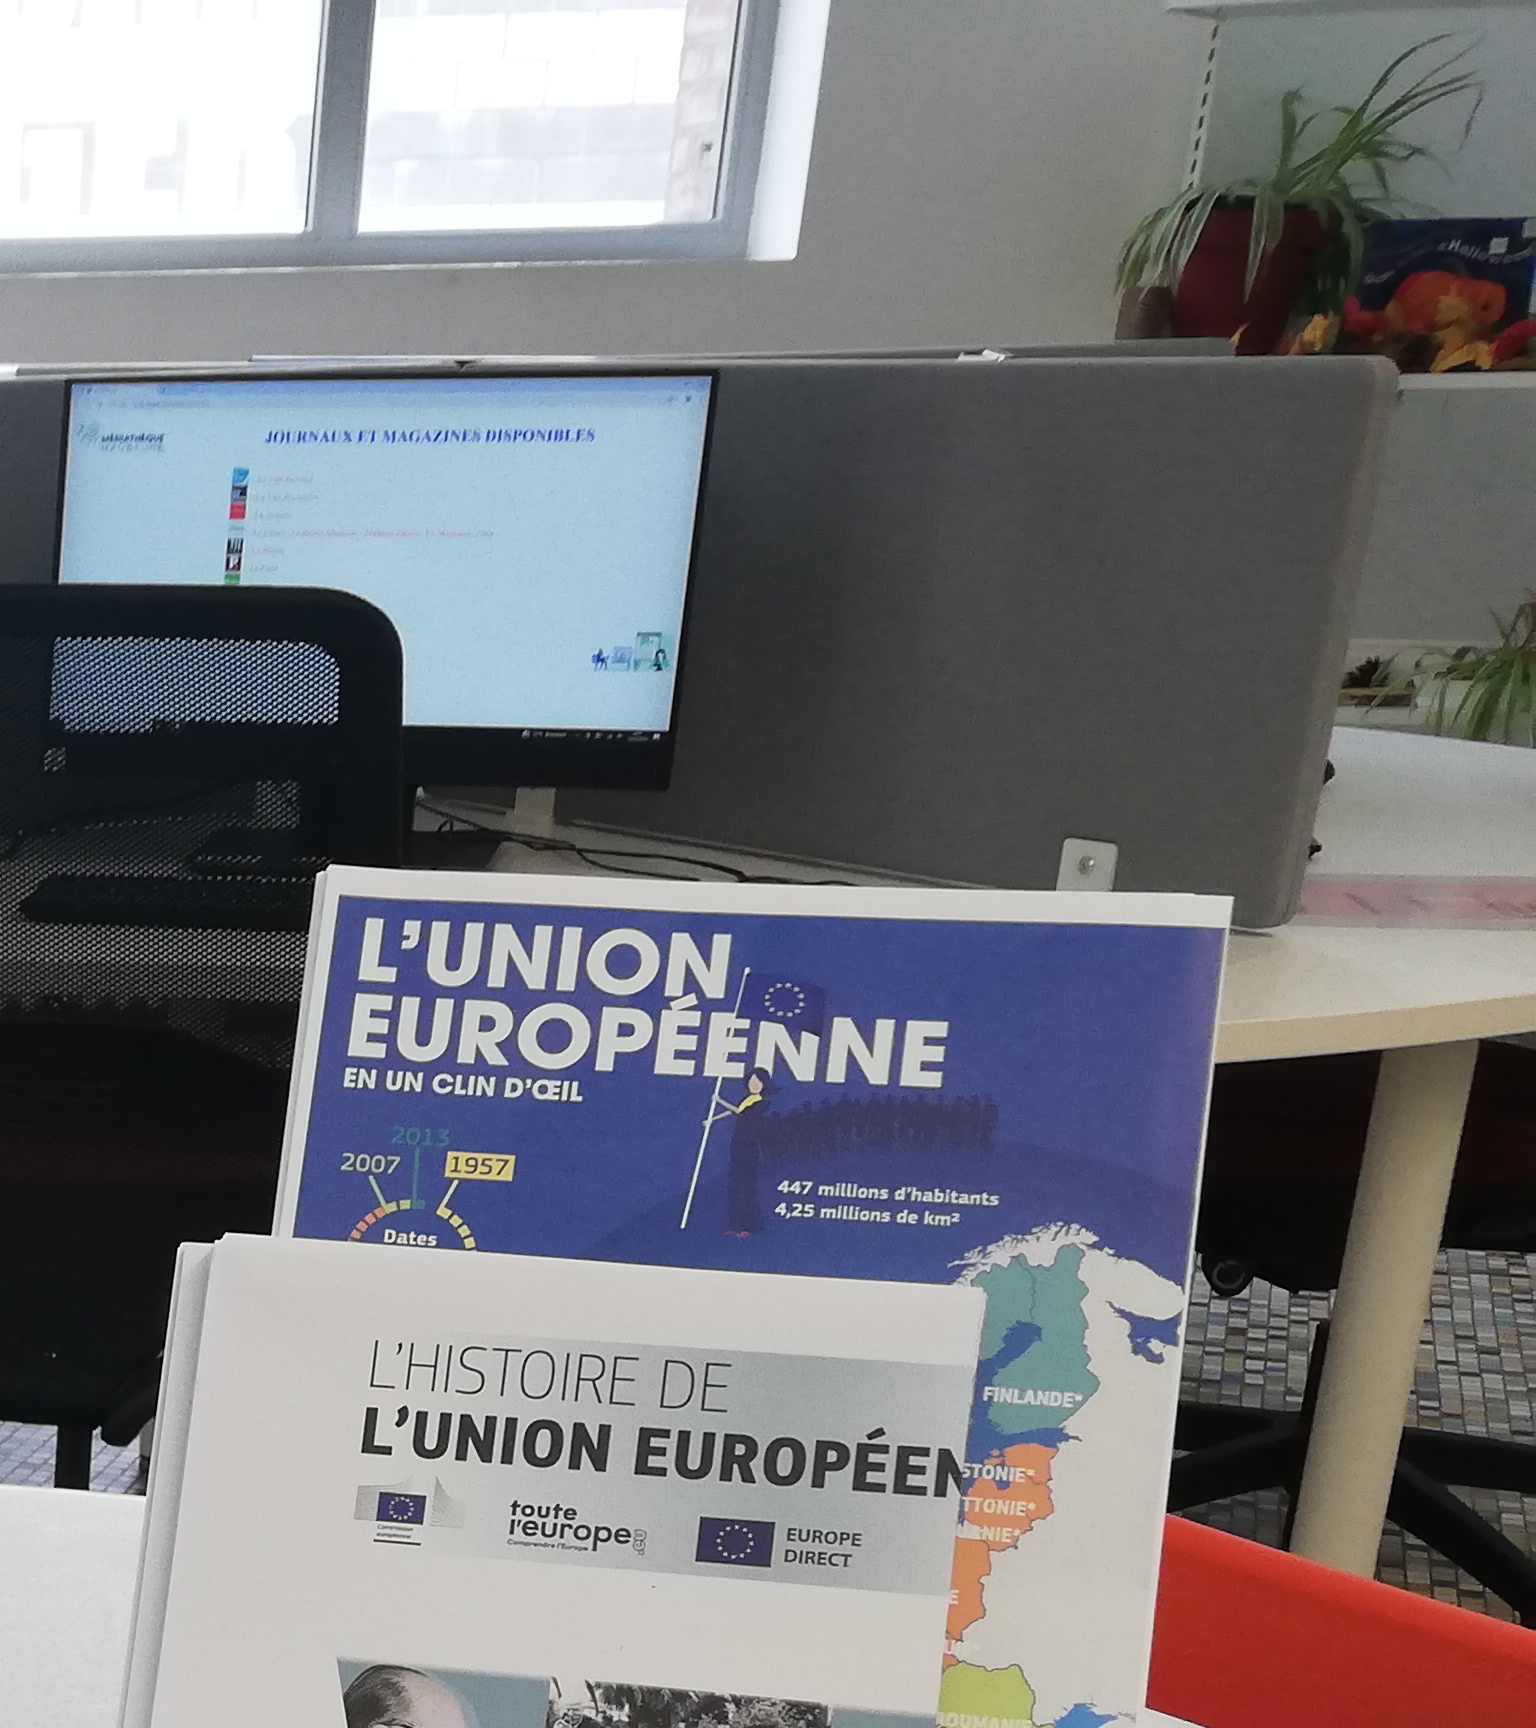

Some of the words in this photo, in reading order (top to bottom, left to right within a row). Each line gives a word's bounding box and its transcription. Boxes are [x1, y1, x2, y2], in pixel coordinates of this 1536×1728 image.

[264, 429, 353, 444] JOURNAUX
[357, 429, 378, 443] ET
[382, 428, 481, 444] MAGAZINES
[485, 428, 596, 443] DISPONIBLES
[358, 917, 732, 999] L'UNION
[346, 992, 949, 1089] EUROPÉENNE
[343, 1067, 377, 1090] EN
[385, 1071, 425, 1092] UN
[432, 1073, 495, 1098] CLIN
[503, 1077, 583, 1103] D'ŒIL
[391, 1125, 449, 1147] 2013
[340, 1153, 400, 1175] 2007
[449, 1155, 510, 1178] 1957
[778, 1178, 811, 1198] 447
[817, 1181, 888, 1203] millions
[895, 1184, 1000, 1208] d'habitants
[775, 1202, 812, 1223] 4,25
[819, 1203, 888, 1225] millions
[895, 1208, 919, 1225] de
[923, 1208, 960, 1229] km²
[383, 1227, 437, 1248] Dates
[368, 1339, 640, 1412] L'HISTOIRE
[662, 1358, 732, 1414] DE
[360, 1406, 609, 1476] L'UNION
[510, 1499, 577, 1521] toute
[508, 1518, 632, 1552] l'europe
[786, 1526, 861, 1550] EUROPE
[784, 1546, 852, 1568] DIRECT
